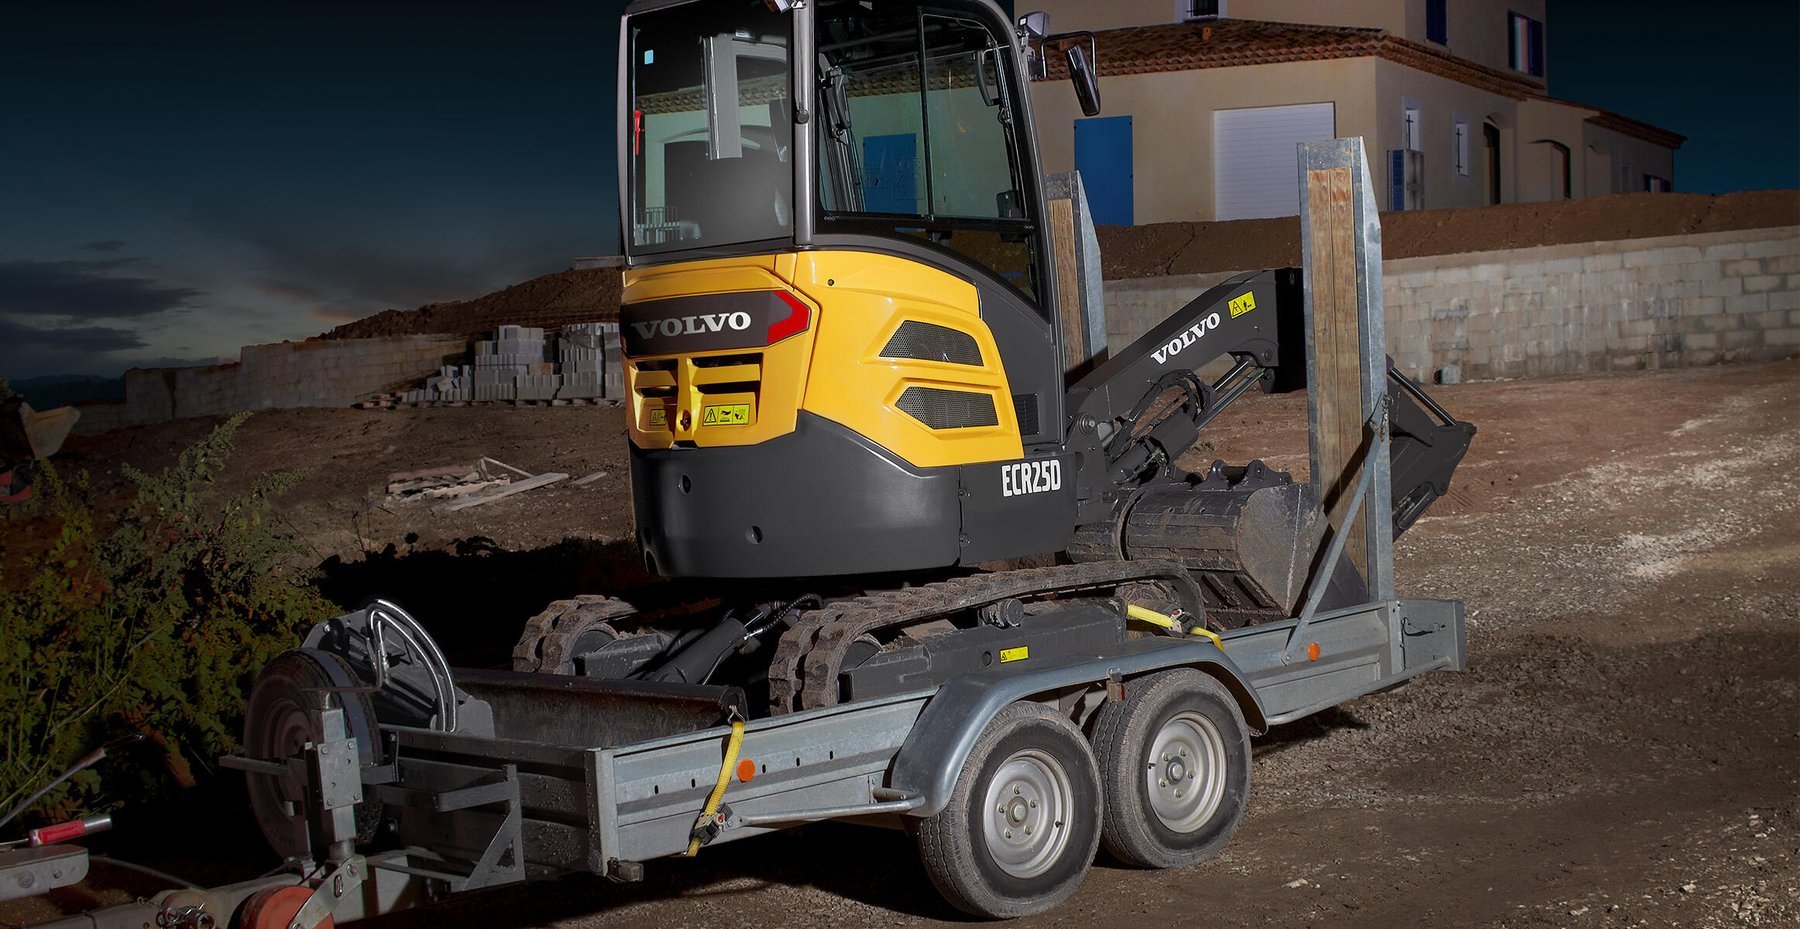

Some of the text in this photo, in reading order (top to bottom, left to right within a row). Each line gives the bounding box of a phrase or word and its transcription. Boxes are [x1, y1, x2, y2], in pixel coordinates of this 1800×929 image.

[632, 312, 751, 340] VOLVO
[1151, 312, 1221, 365] VOLVO
[1002, 459, 1061, 497] ECR25D
